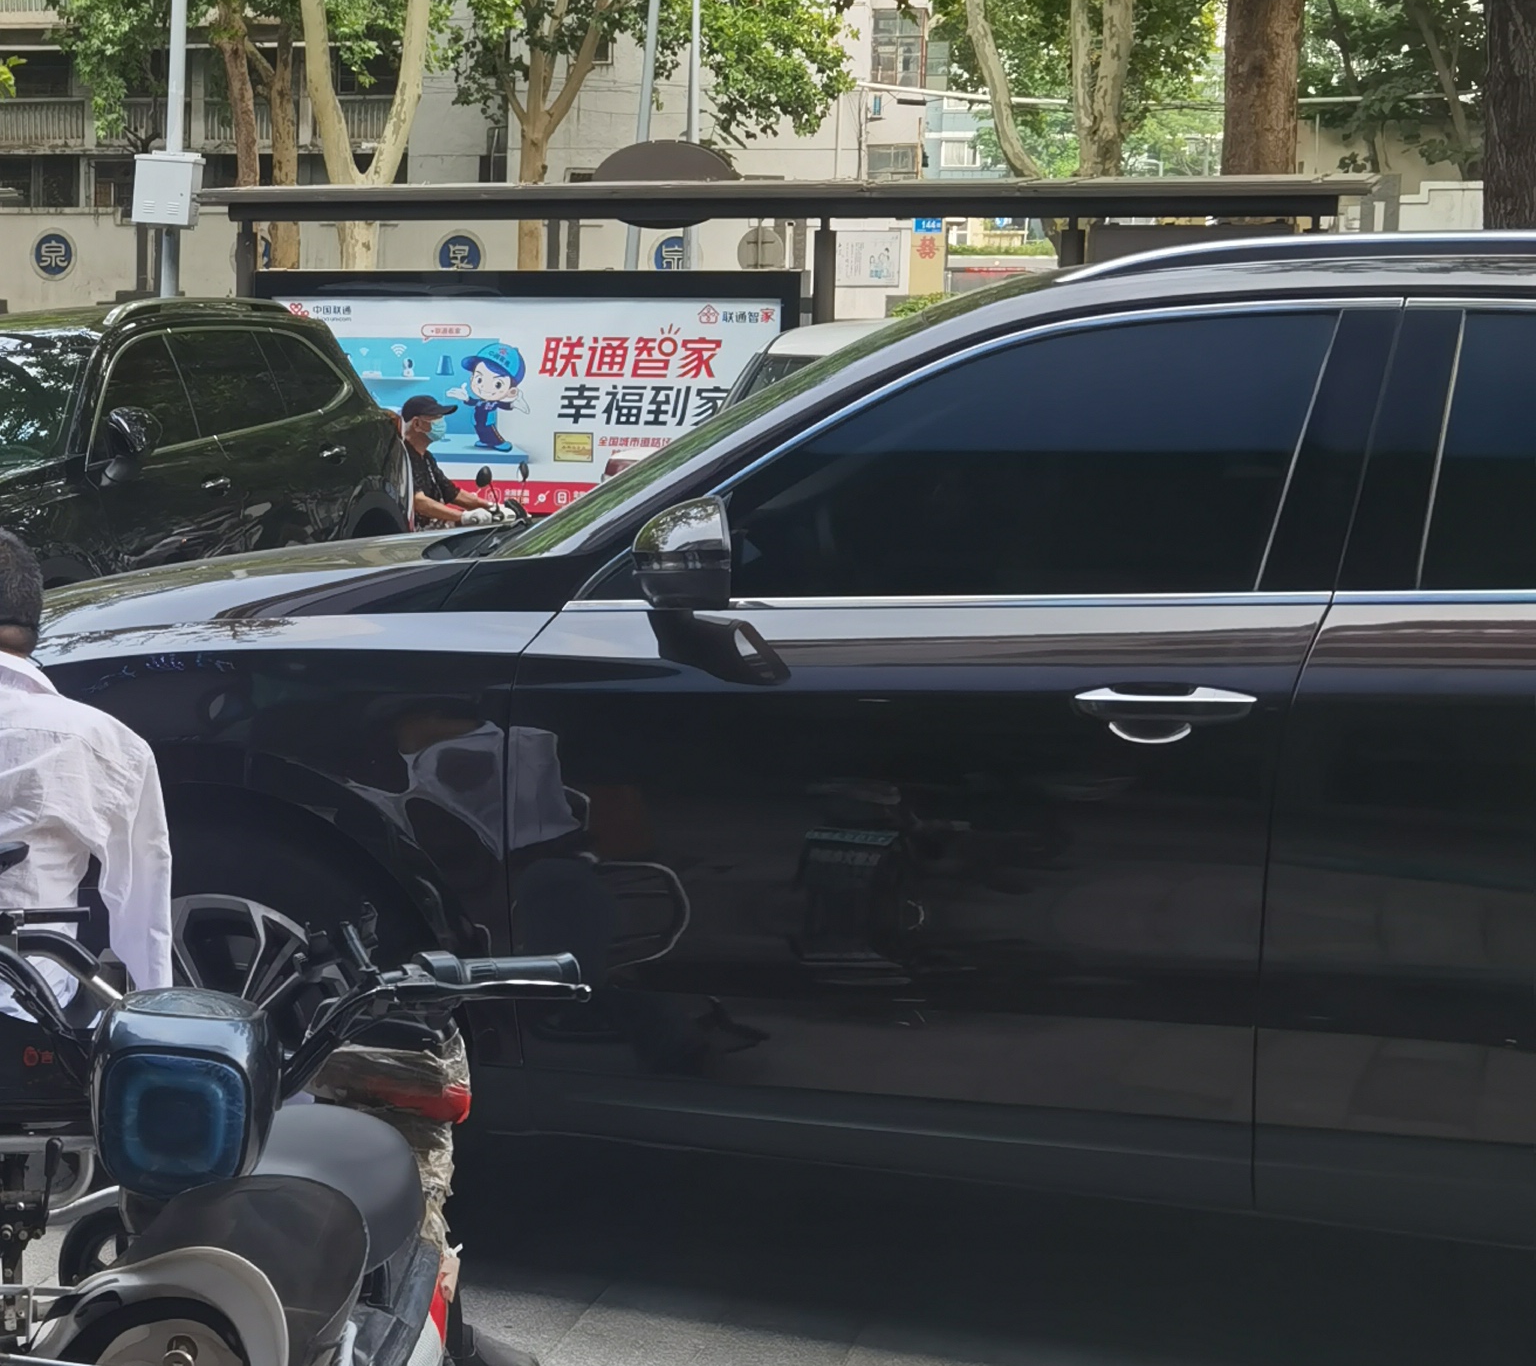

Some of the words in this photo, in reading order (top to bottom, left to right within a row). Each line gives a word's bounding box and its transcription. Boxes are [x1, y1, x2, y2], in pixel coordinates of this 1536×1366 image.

[39, 240, 68, 268] 泉
[312, 305, 352, 315] 中国联通
[721, 307, 776, 323] 联通智家
[539, 336, 723, 379] 联通智家
[557, 384, 732, 427] 幸福到家
